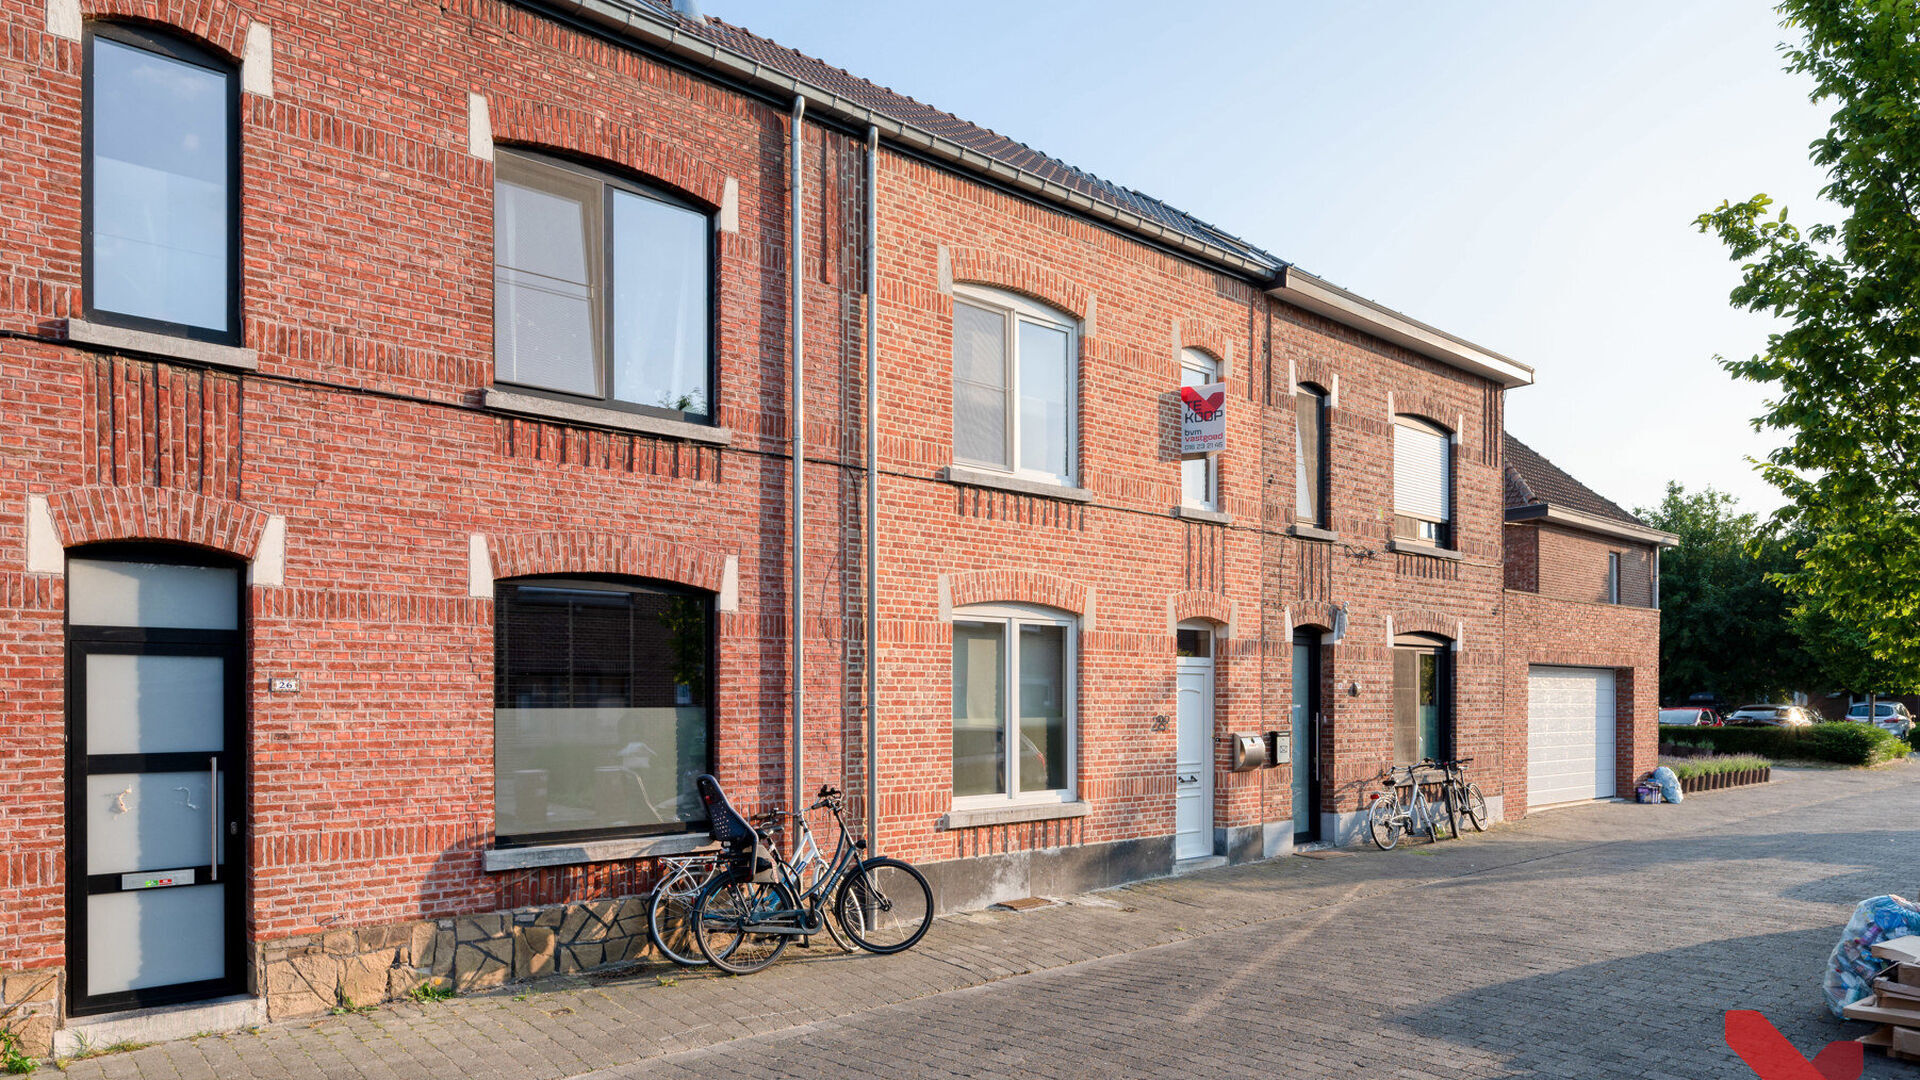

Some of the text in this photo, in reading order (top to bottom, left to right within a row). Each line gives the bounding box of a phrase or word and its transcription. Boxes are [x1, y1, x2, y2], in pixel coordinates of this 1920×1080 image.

[1186, 400, 1202, 412] TE
[1185, 409, 1223, 424] KOOP
[1185, 429, 1202, 437] bvm
[1185, 433, 1223, 443] vastgoed
[279, 681, 293, 689] 26
